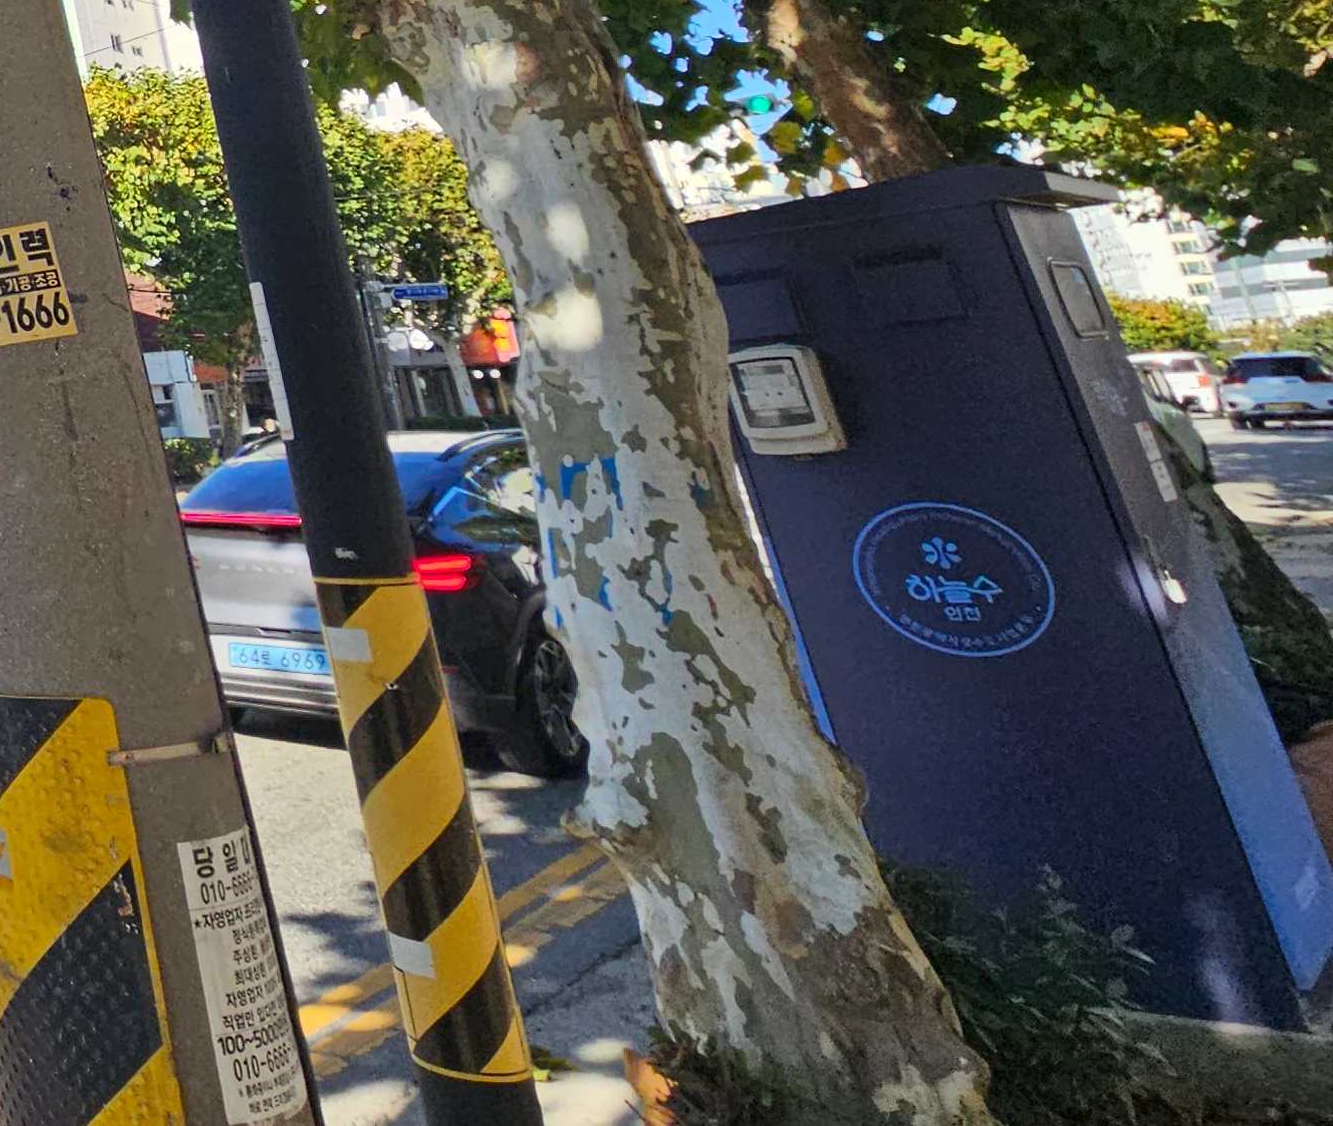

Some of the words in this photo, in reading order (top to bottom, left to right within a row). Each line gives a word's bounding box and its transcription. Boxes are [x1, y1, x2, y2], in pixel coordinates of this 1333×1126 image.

[905, 574, 1003, 604] 하늘수
[944, 606, 982, 622] 인천
[239, 648, 272, 666] 64로
[280, 651, 326, 671] 6969
[225, 985, 264, 1008] 자영업자
[222, 1011, 255, 1032] 직업만
